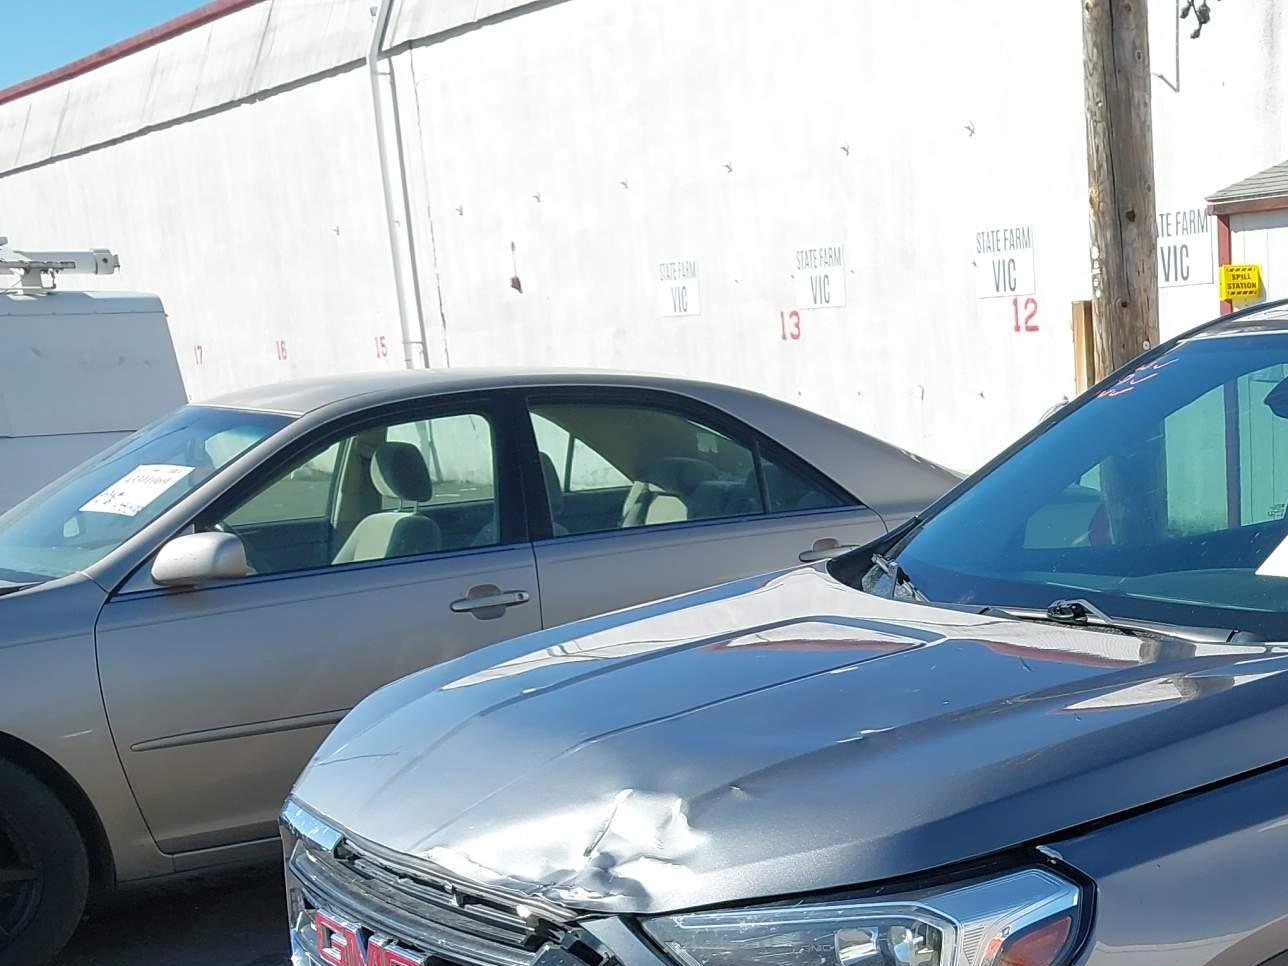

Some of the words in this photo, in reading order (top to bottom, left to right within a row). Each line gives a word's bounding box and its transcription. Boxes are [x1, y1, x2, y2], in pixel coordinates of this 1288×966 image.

[1175, 208, 1208, 236] FARM
[976, 229, 1001, 254] STATE
[1003, 226, 1031, 251] FARM
[796, 249, 817, 270] STATE
[819, 247, 842, 267] FARM
[1160, 243, 1190, 282] VIC
[810, 274, 831, 304] VIC
[993, 258, 1017, 292] VIC
[1227, 282, 1257, 290] STATION
[1231, 273, 1252, 281] SPILL
[670, 285, 688, 313] VIC
[780, 310, 801, 341] 13
[1012, 296, 1039, 332] 12
[276, 340, 288, 361] 16
[374, 335, 388, 358] 15
